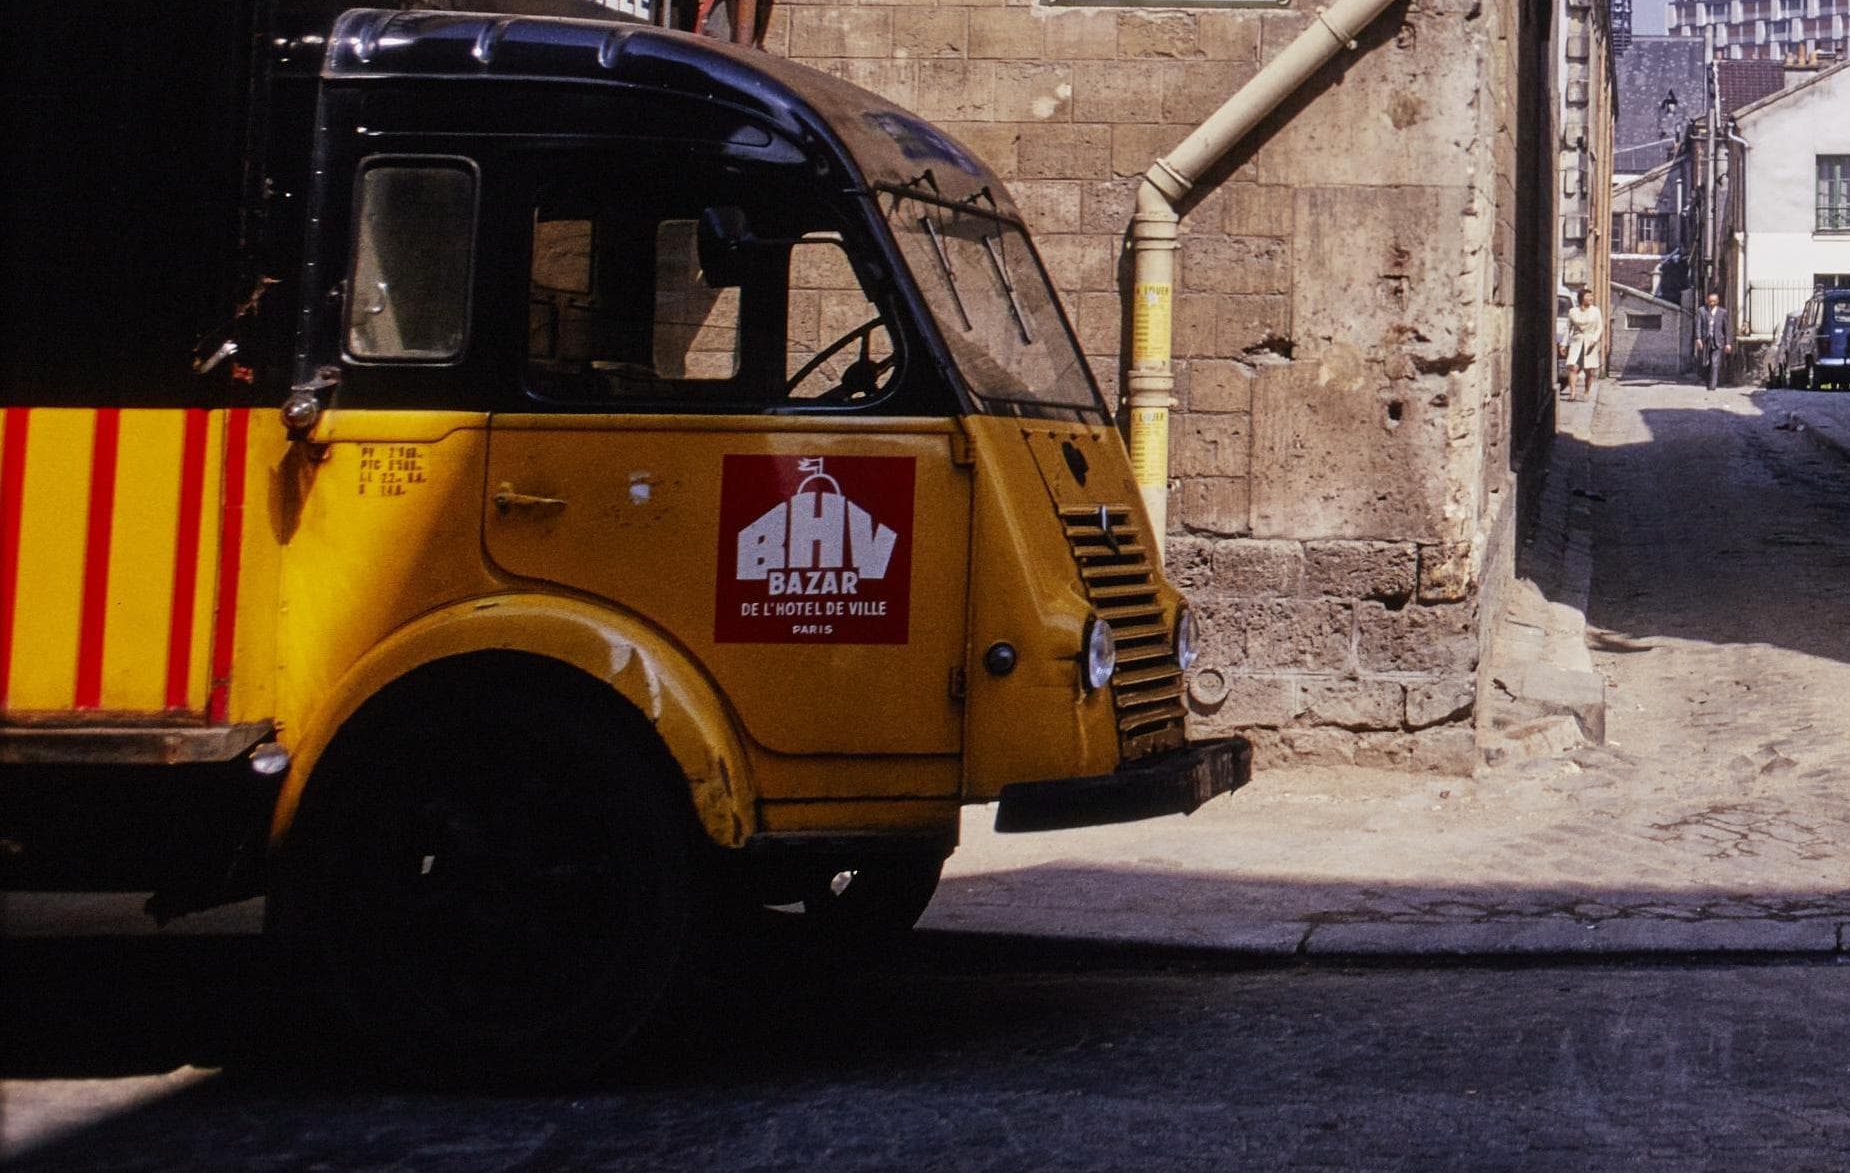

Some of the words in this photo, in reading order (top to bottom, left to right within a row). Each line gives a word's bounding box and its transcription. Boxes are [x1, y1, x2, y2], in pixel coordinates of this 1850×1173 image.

[736, 491, 898, 580] BHV
[768, 571, 858, 596] BAZAR
[741, 602, 759, 616] DE
[763, 601, 822, 616] L'HOTEL
[826, 601, 845, 616] DE
[849, 601, 887, 616] VILLE
[792, 625, 833, 635] PARIS
